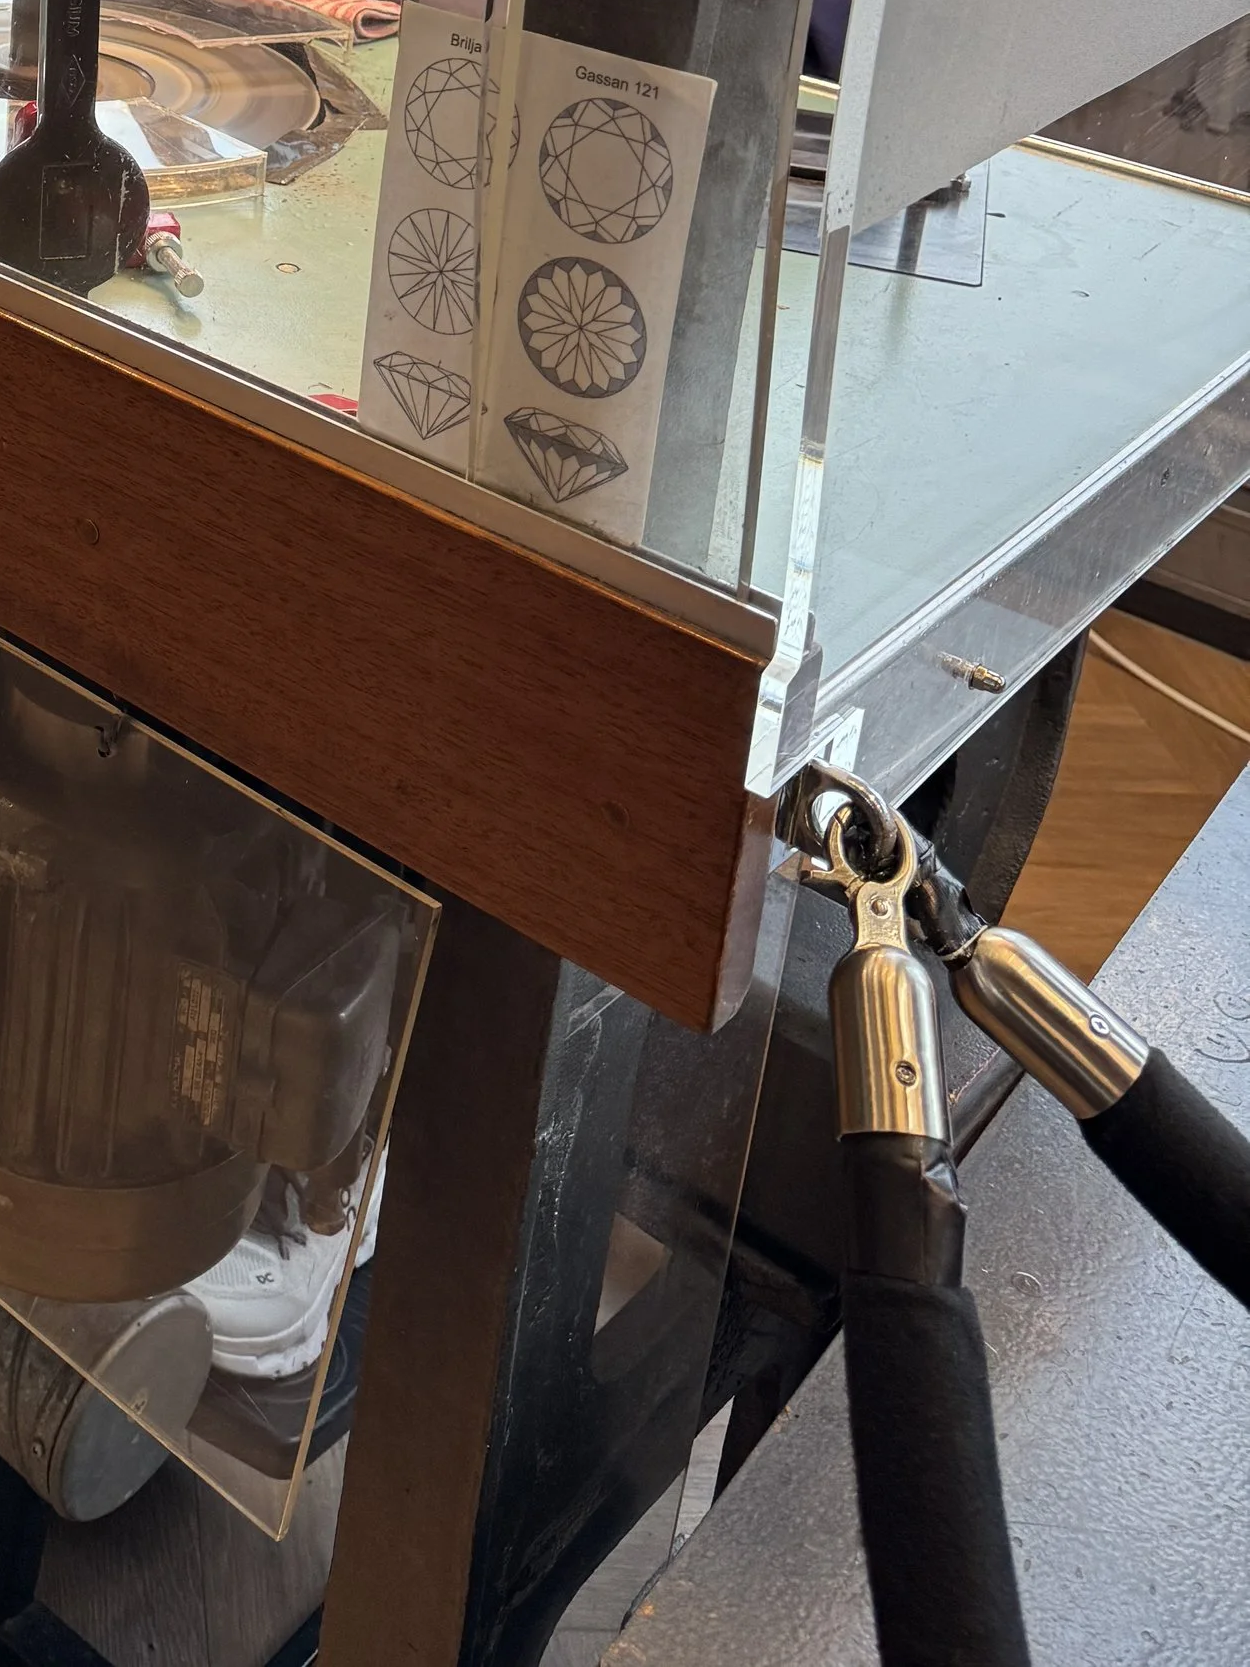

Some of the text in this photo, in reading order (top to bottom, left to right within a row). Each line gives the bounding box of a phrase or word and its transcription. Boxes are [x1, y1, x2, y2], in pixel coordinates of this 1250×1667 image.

[450, 32, 482, 54] Brilja
[574, 65, 660, 100] Gassan 121
[256, 1272, 275, 1285] DC
